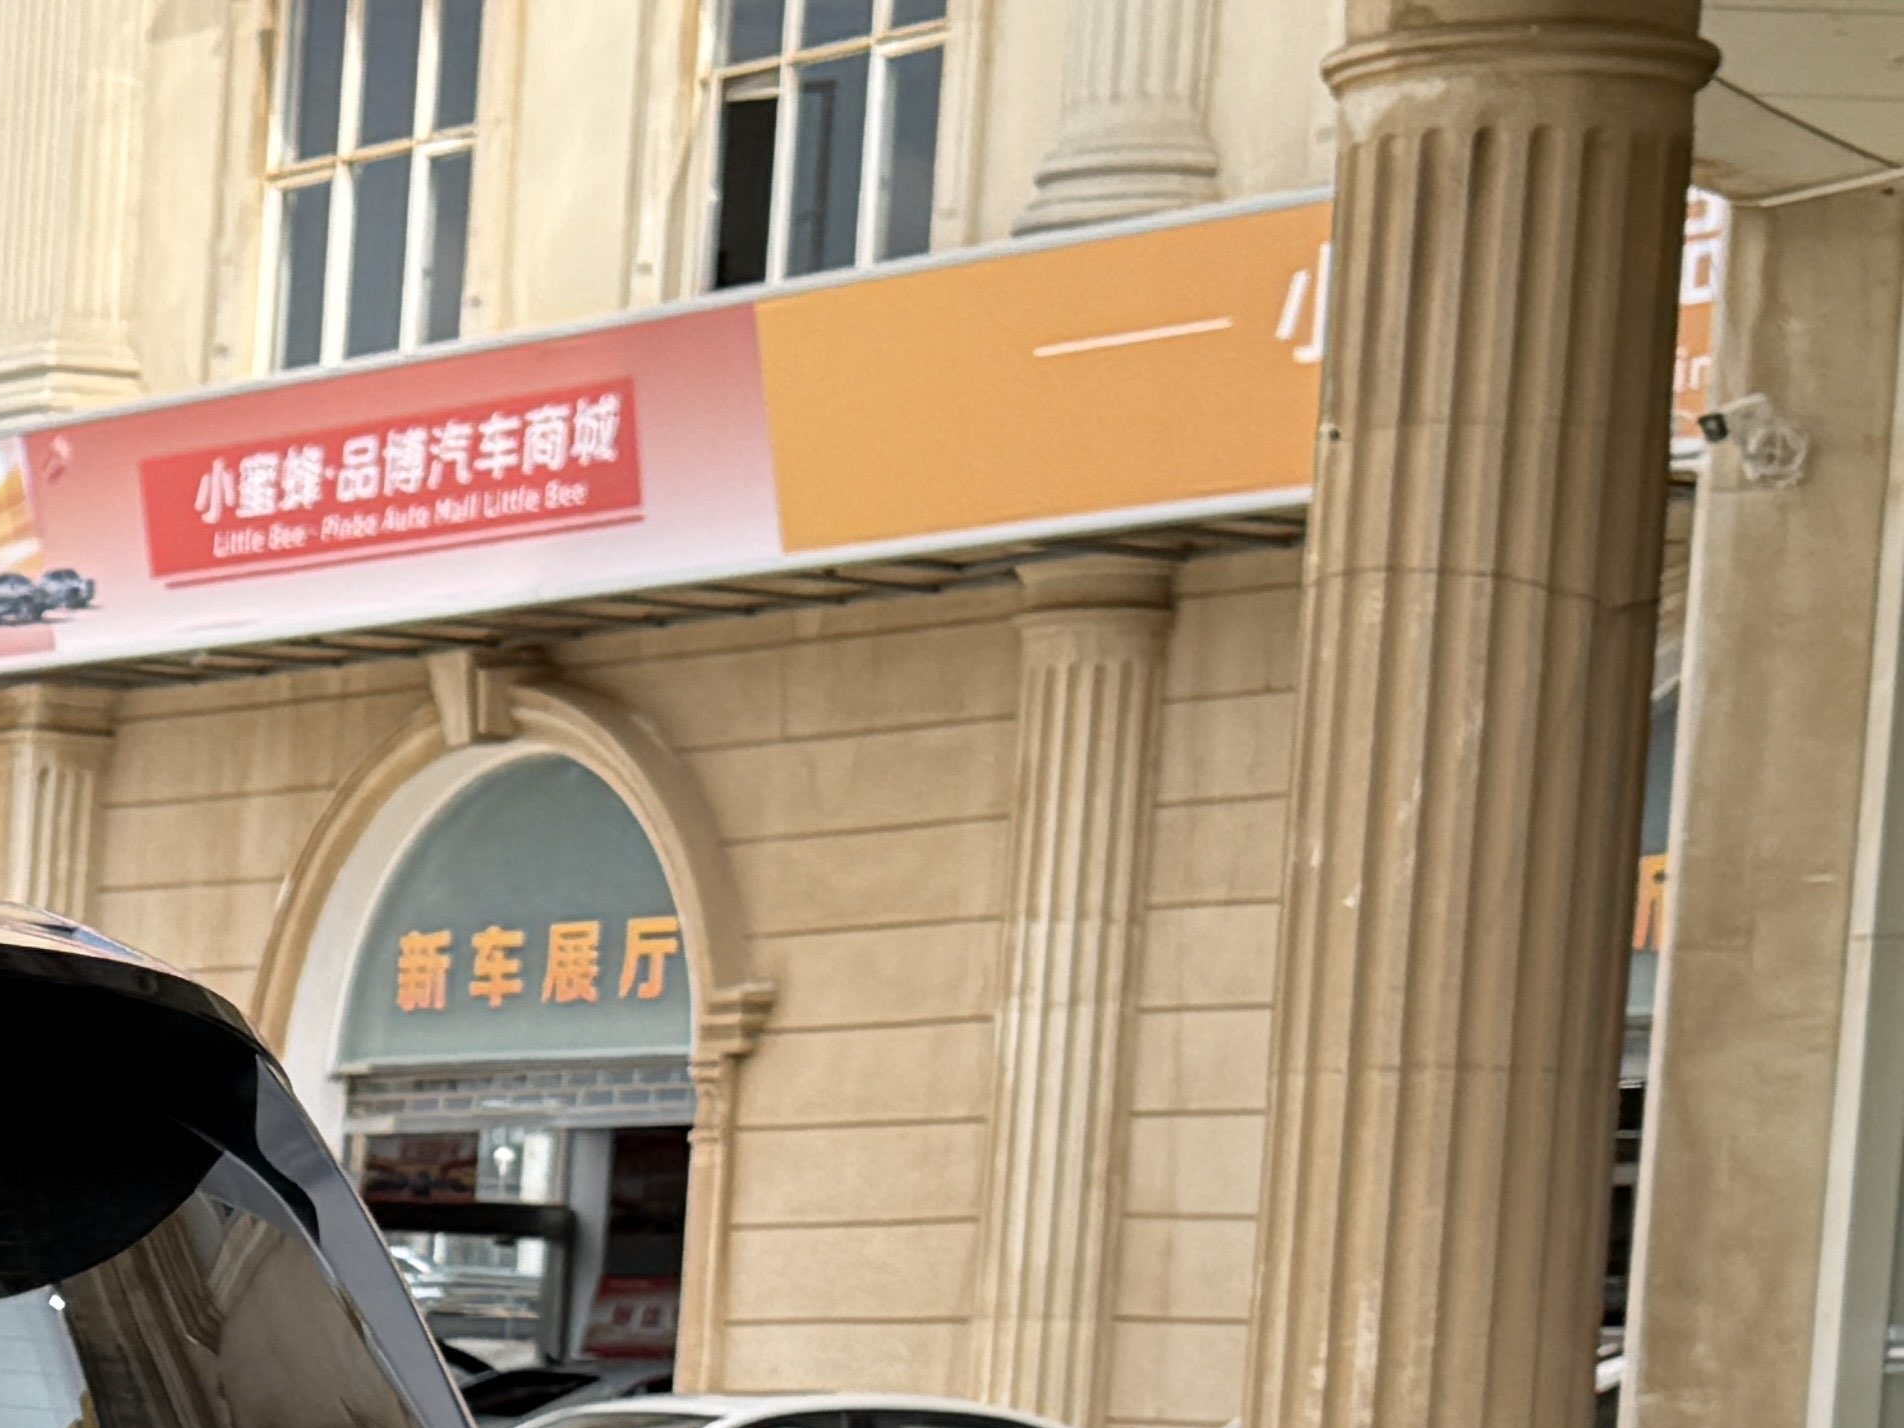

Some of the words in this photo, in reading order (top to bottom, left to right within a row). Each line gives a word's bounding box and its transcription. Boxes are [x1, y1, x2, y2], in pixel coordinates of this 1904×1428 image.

[213, 526, 265, 558] Little
[267, 522, 307, 551] Bee
[382, 503, 430, 532] Auto
[434, 491, 480, 525] Mall
[483, 485, 541, 518] Little
[544, 478, 589, 510] Bee
[396, 915, 681, 1012] 新车展厅
